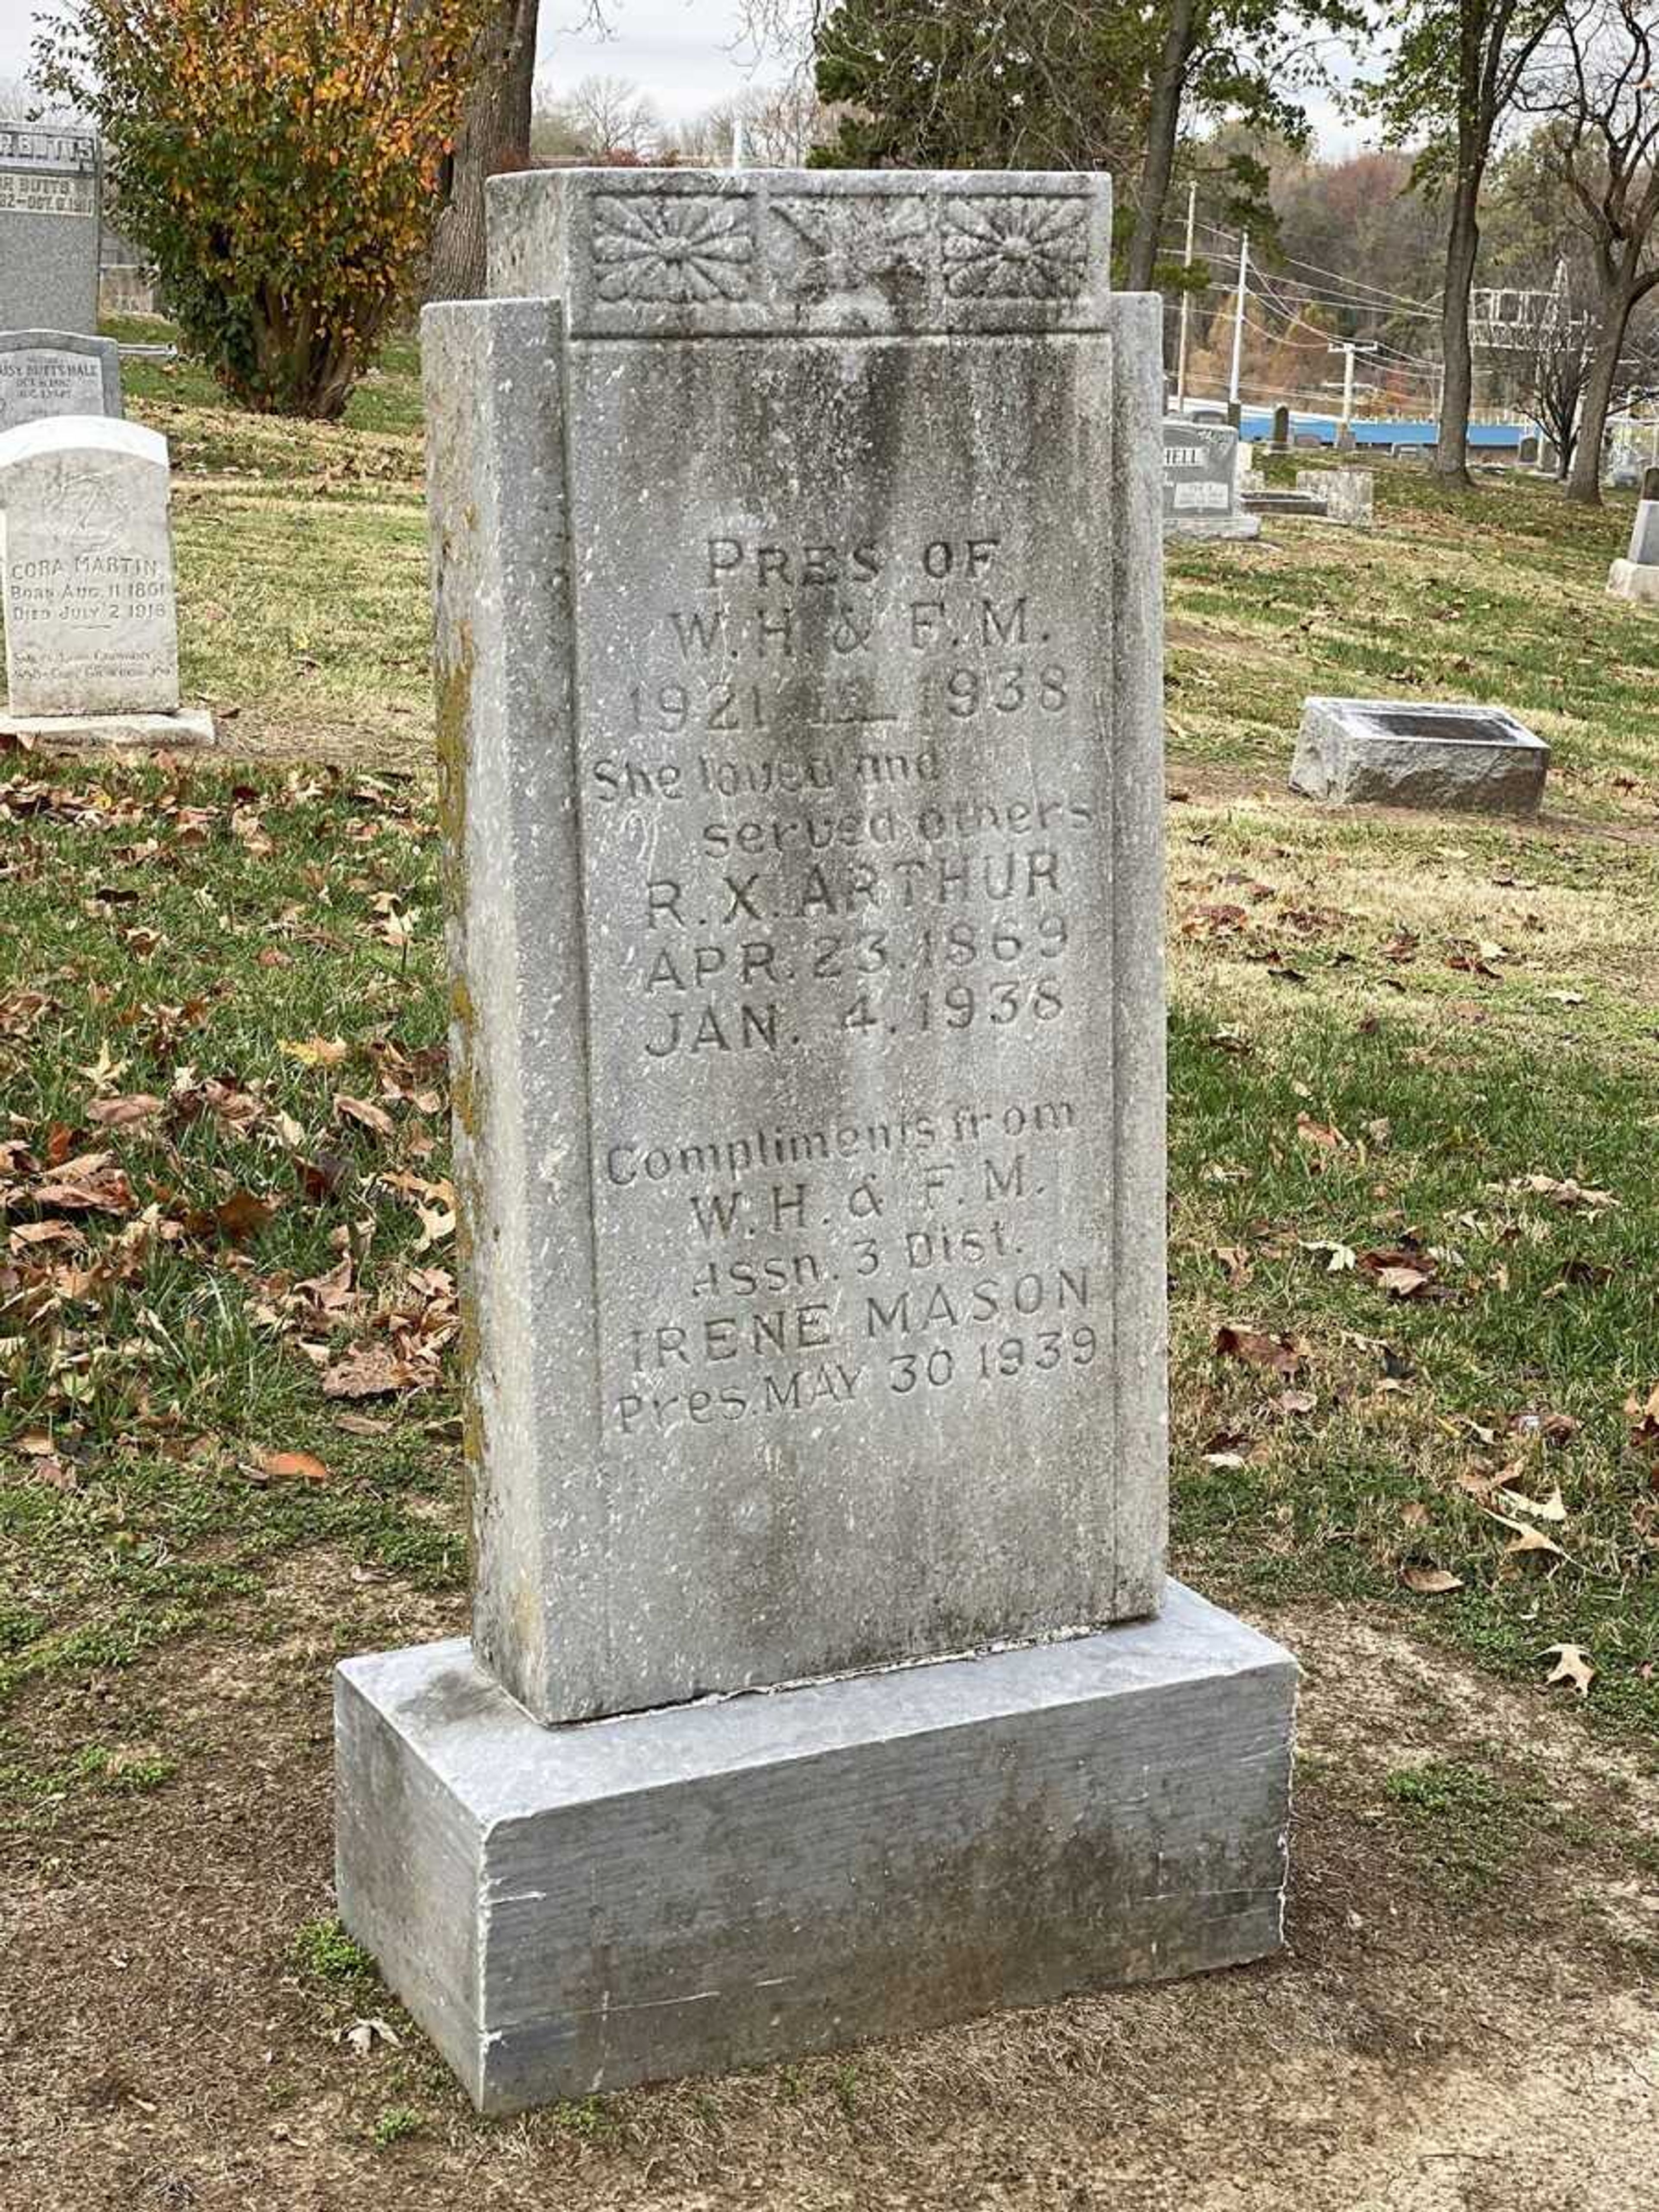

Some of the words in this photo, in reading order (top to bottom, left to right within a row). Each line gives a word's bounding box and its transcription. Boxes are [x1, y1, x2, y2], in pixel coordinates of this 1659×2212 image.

[12, 558, 63, 580] CORA
[707, 538, 880, 587] PRES
[923, 538, 1000, 580] OF
[108, 604, 120, 619] 2
[109, 584, 119, 597] 11
[631, 684, 764, 732] 1921
[593, 757, 683, 802] She
[702, 806, 898, 861] served
[917, 799, 1094, 842] others
[607, 1116, 935, 1185] Compliments
[952, 1100, 1076, 1144] from
[853, 1238, 881, 1277] 3
[629, 1303, 832, 1374] IRENE
[865, 1265, 1090, 1339] MASON
[887, 1348, 955, 1395] 30
[979, 1325, 1098, 1379] 1939
